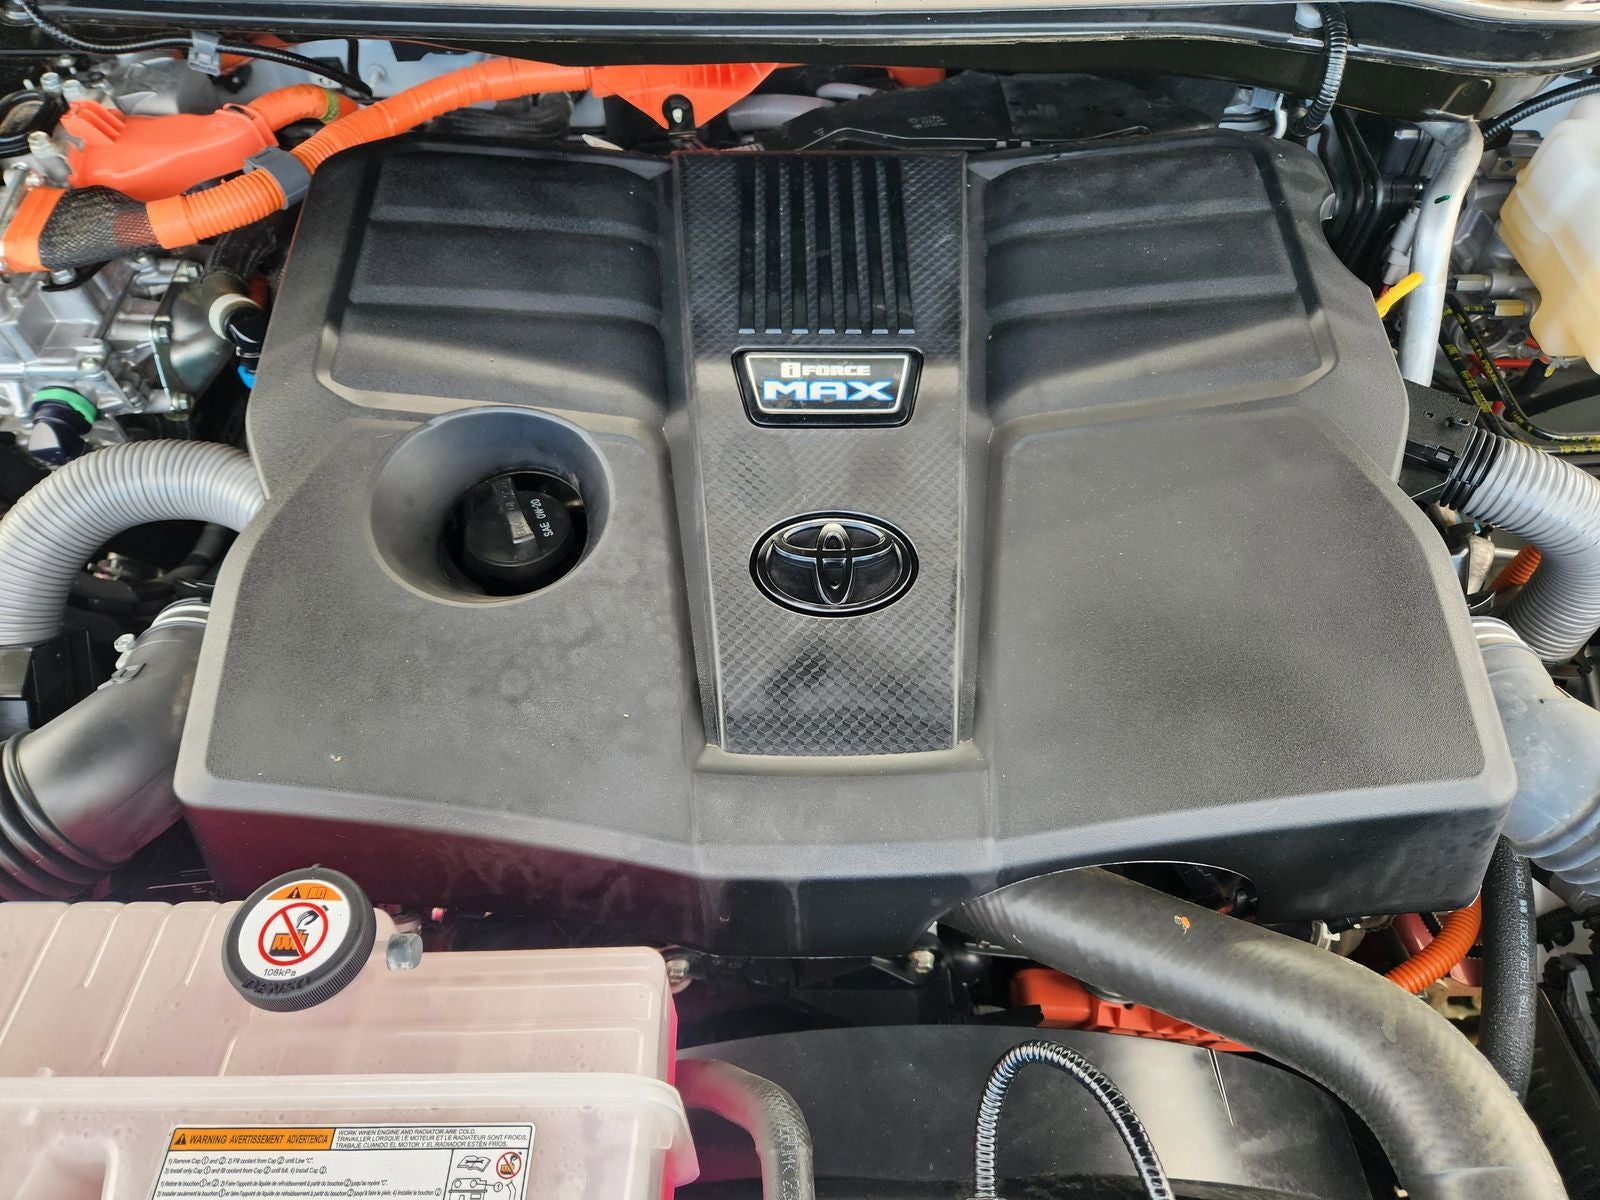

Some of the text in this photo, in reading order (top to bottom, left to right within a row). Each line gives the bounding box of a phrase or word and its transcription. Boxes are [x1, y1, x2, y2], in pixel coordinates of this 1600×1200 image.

[763, 381, 894, 401] MAX
[540, 521, 554, 537] SAE
[263, 968, 297, 977] 108kPa
[241, 976, 311, 996] DENSO
[190, 1134, 328, 1144] WARNING AVERTISSEMENT ADVERTENCIA
